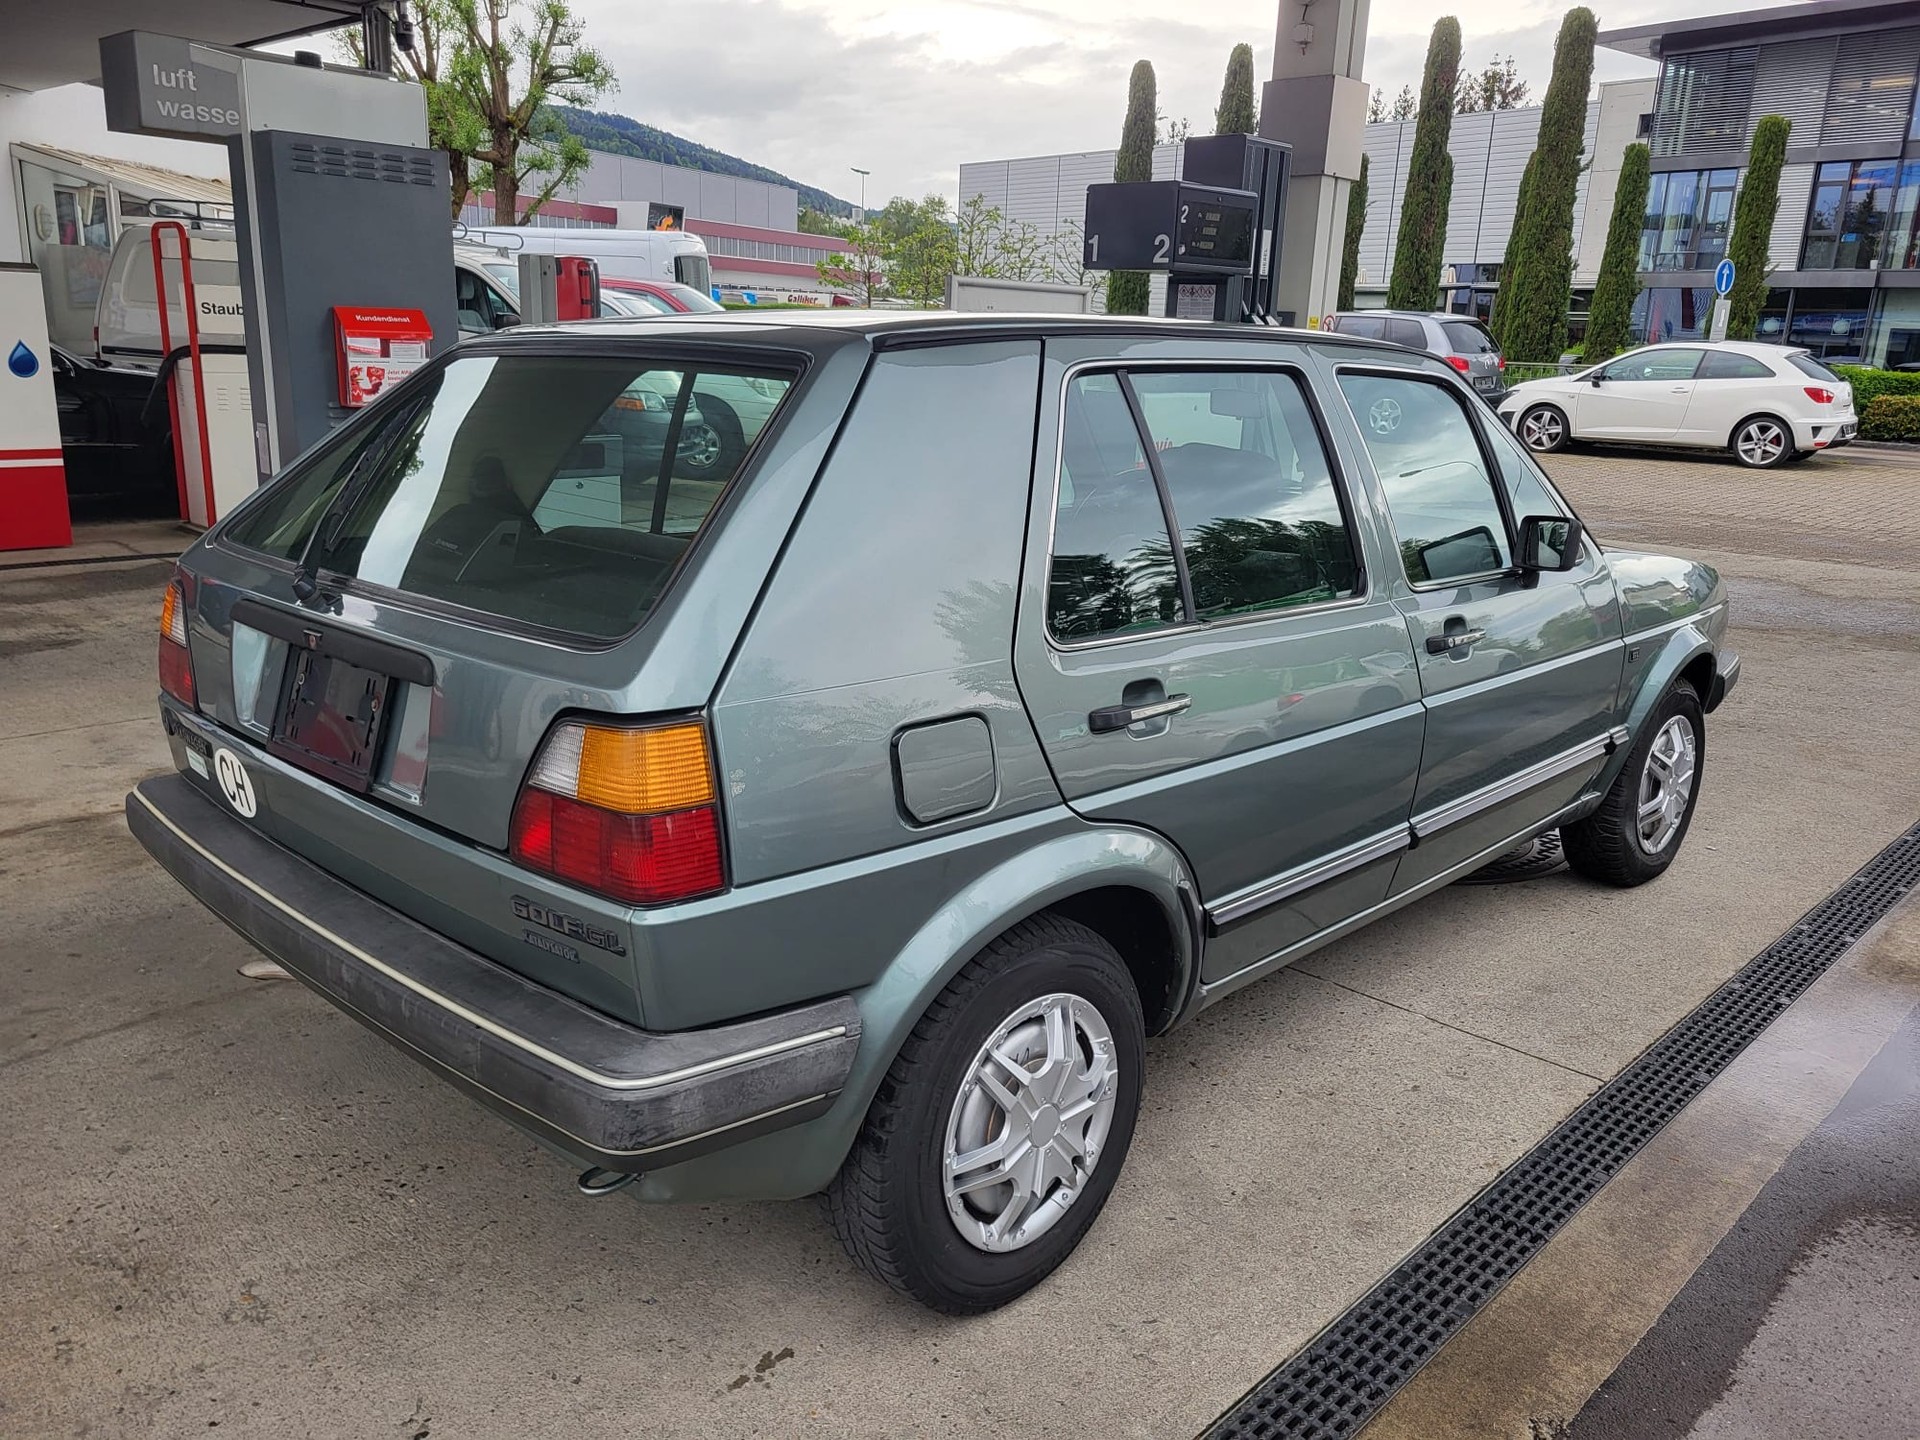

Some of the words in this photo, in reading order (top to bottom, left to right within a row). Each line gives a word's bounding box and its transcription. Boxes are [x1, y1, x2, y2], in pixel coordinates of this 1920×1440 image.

[152, 64, 197, 91] luft
[1181, 204, 1189, 224] 2
[1088, 234, 1099, 262] 1
[1152, 233, 1170, 264] 2
[201, 302, 245, 316] Staub
[787, 294, 819, 305] Galliker
[355, 314, 411, 323] Kundendienst
[219, 754, 253, 814] CH
[511, 894, 586, 940] GOLF
[585, 922, 627, 957] GL
